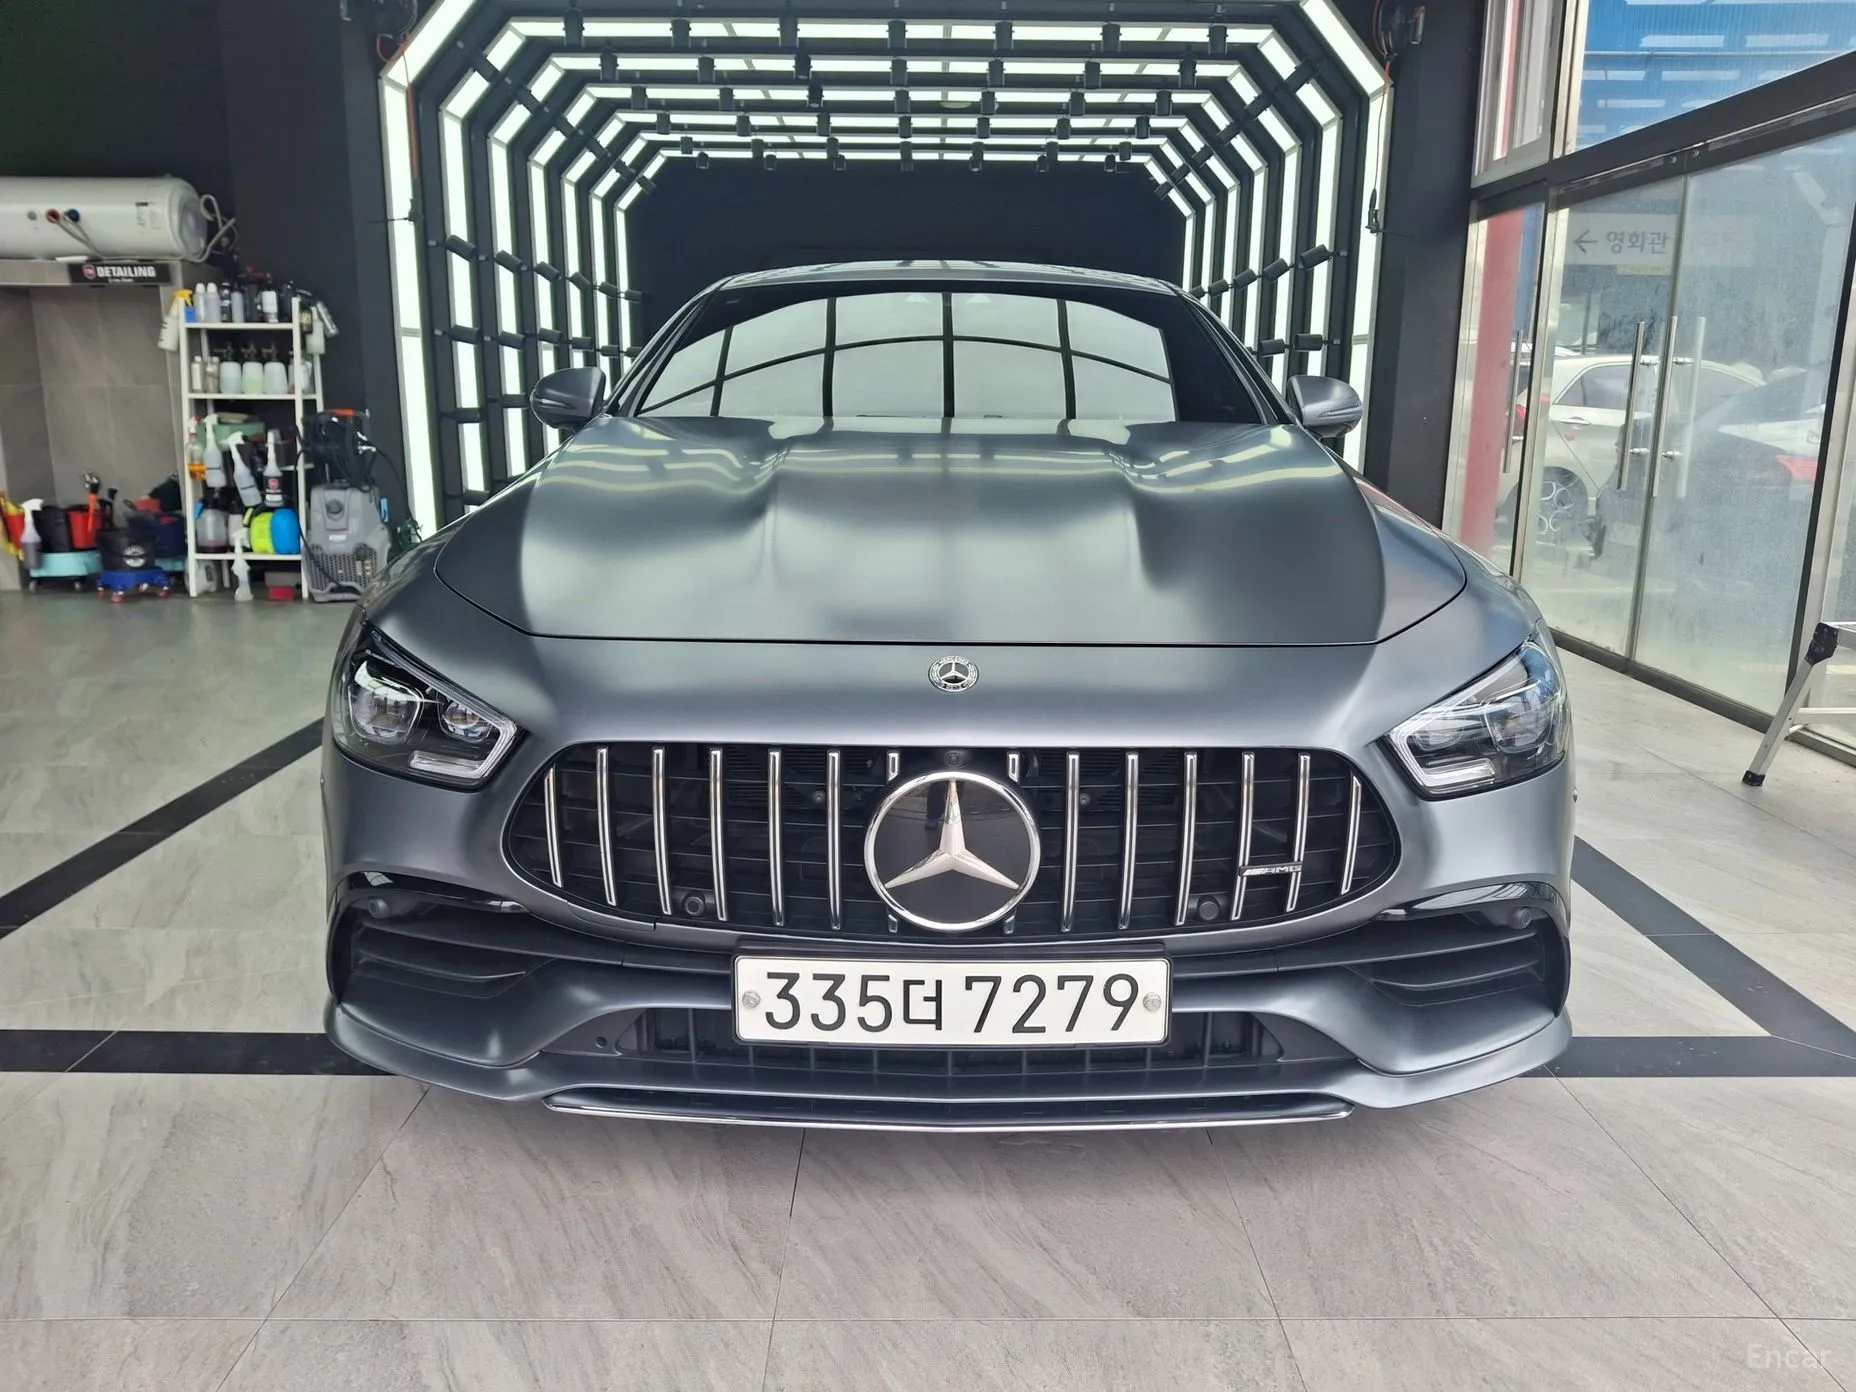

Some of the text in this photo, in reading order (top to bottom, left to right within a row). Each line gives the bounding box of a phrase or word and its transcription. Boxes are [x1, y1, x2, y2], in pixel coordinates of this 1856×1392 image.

[1605, 230, 1669, 254] 영화관
[97, 266, 157, 278] DETAILING
[965, 973, 1140, 1033] 7279
